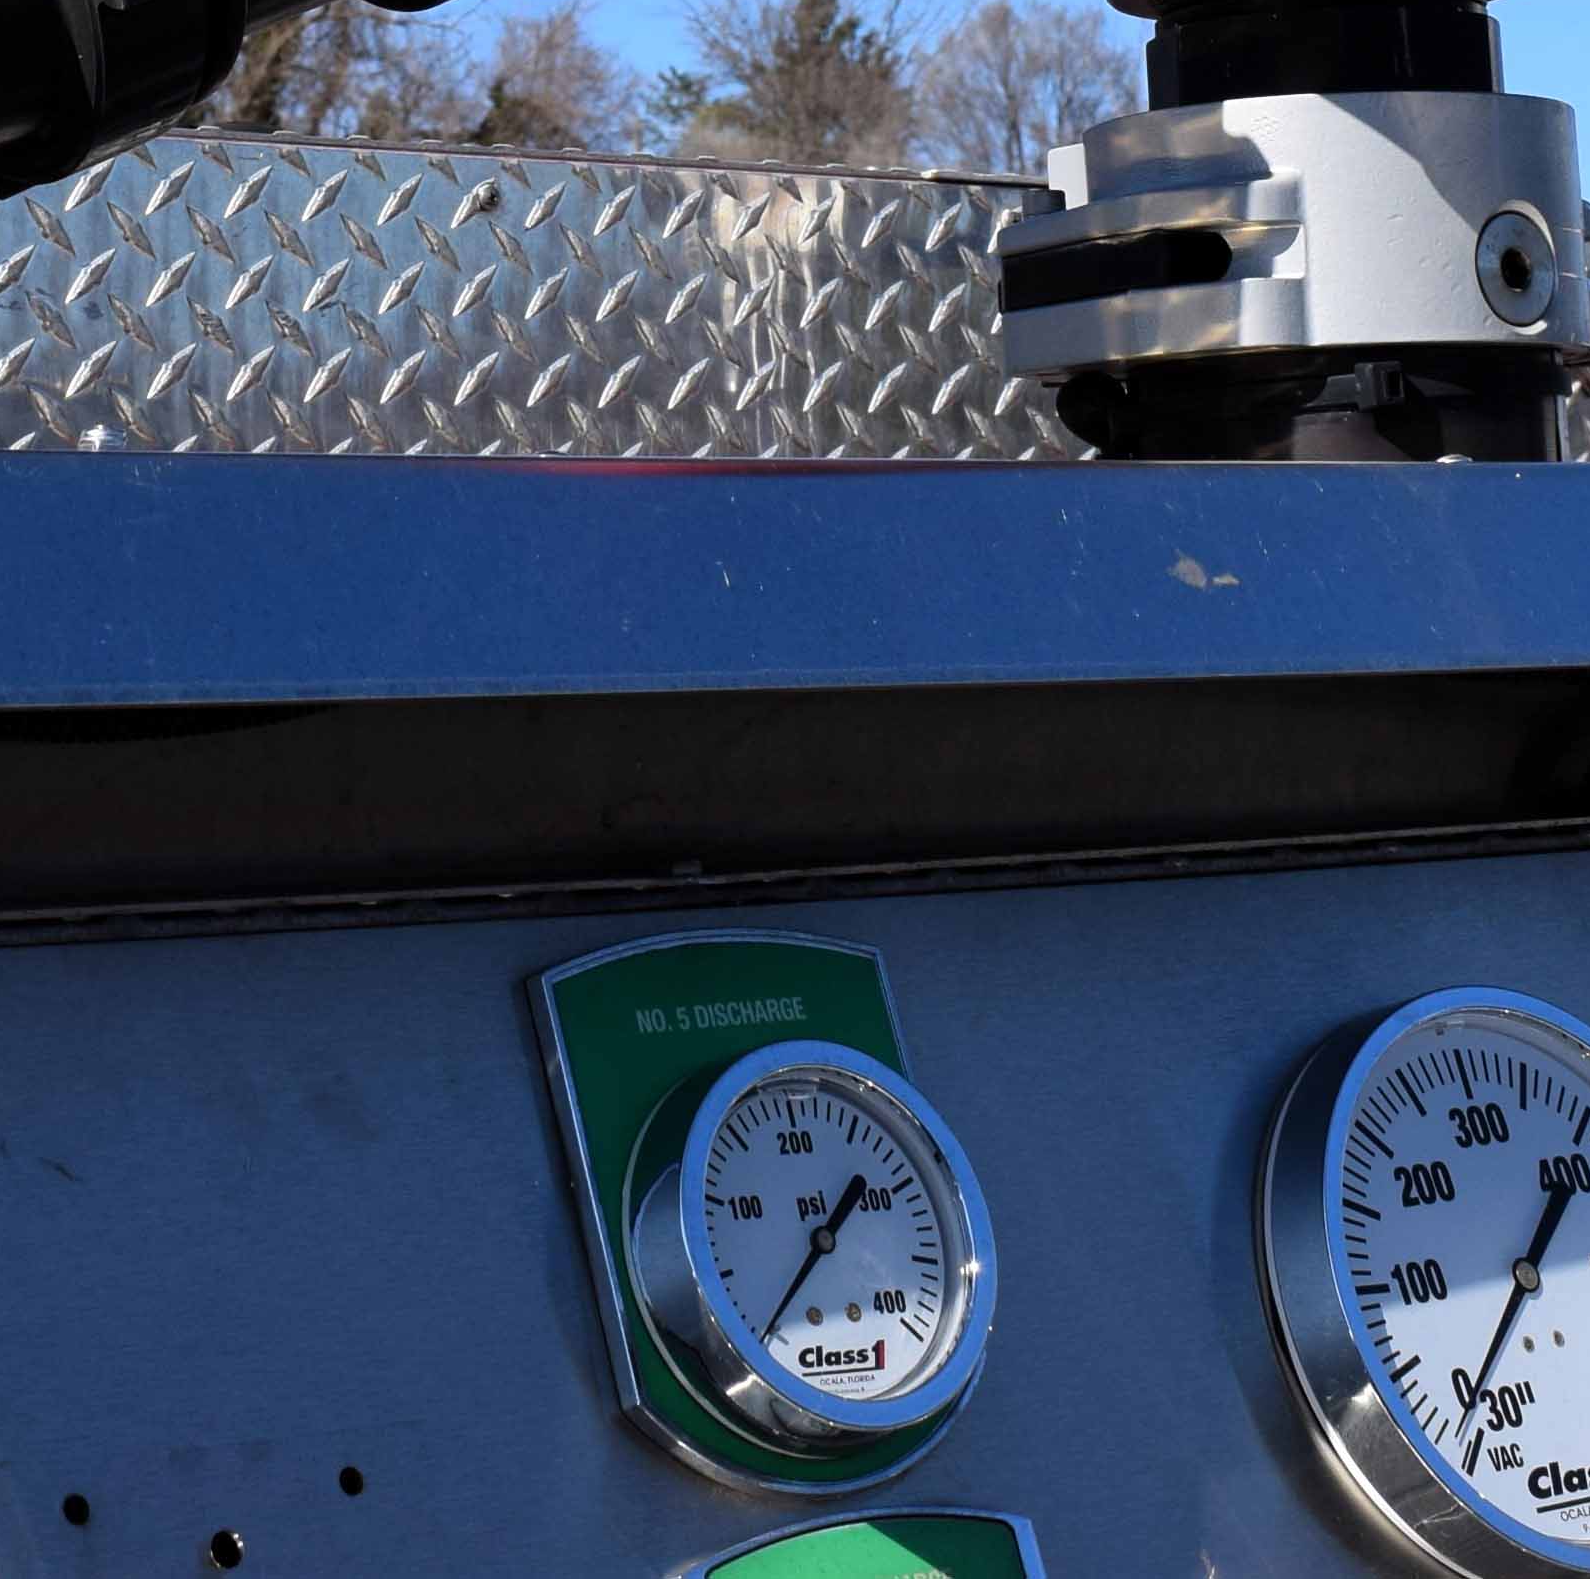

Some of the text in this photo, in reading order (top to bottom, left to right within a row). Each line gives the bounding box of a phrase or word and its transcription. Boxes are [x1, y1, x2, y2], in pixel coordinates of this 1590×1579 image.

[636, 997, 807, 1035] NO. 5 DISCHARGE
[1449, 1102, 1510, 1149] 300
[777, 1131, 814, 1156] 200
[1394, 1160, 1456, 1208] 200
[728, 1195, 764, 1221] 100
[797, 1192, 828, 1222] psi
[858, 1187, 893, 1214] 300
[1391, 1258, 1448, 1306] 100
[873, 1289, 907, 1315] 400
[1451, 1367, 1476, 1410] 0
[1487, 1442, 1524, 1472] VAC
